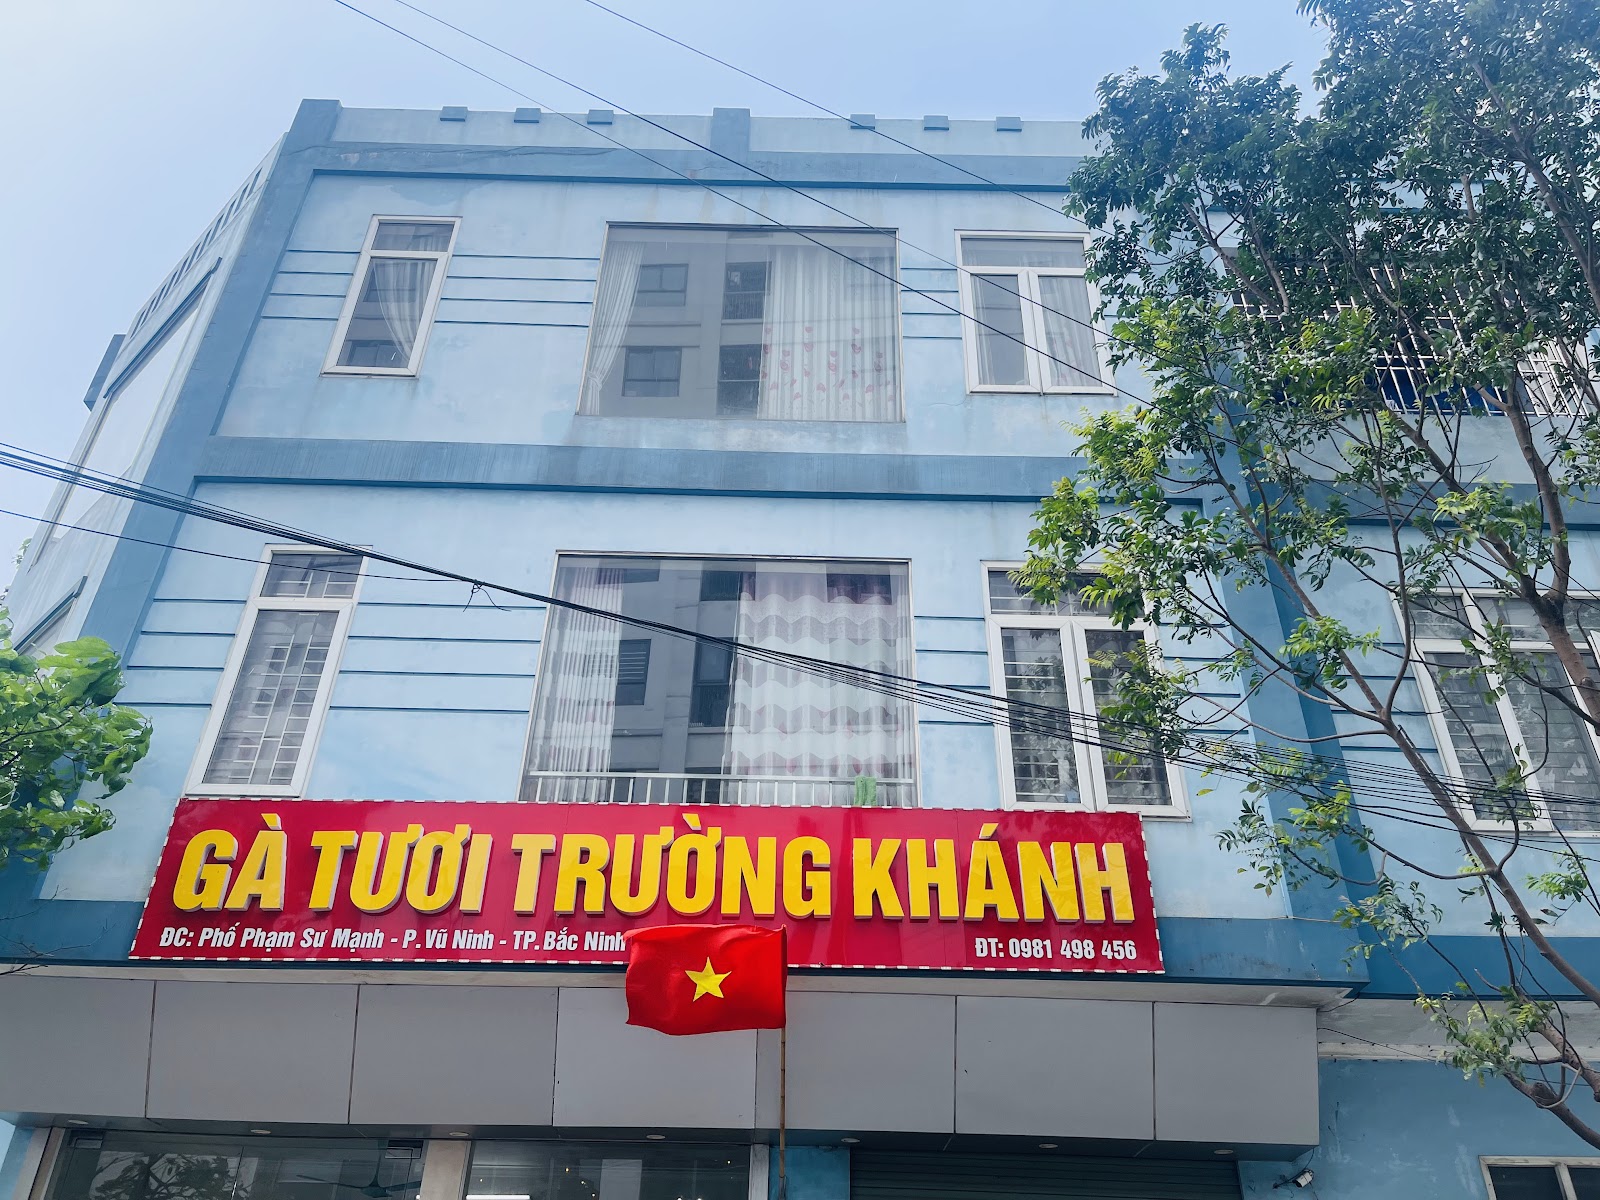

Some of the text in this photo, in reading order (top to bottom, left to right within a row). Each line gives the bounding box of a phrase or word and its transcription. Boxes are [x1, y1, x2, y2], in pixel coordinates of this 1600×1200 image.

[172, 813, 1136, 924] GÀ TƯƠI TRƯỜNG KHÁNH
[159, 926, 195, 947] ĐC:
[198, 922, 241, 947] Phố
[240, 927, 296, 952] Phạm
[300, 928, 329, 948] Sư
[331, 928, 385, 952] Mạnh
[452, 929, 494, 949] Ninh
[584, 929, 626, 951] Ninh
[975, 937, 1137, 960] ĐT: 0981 498 456
